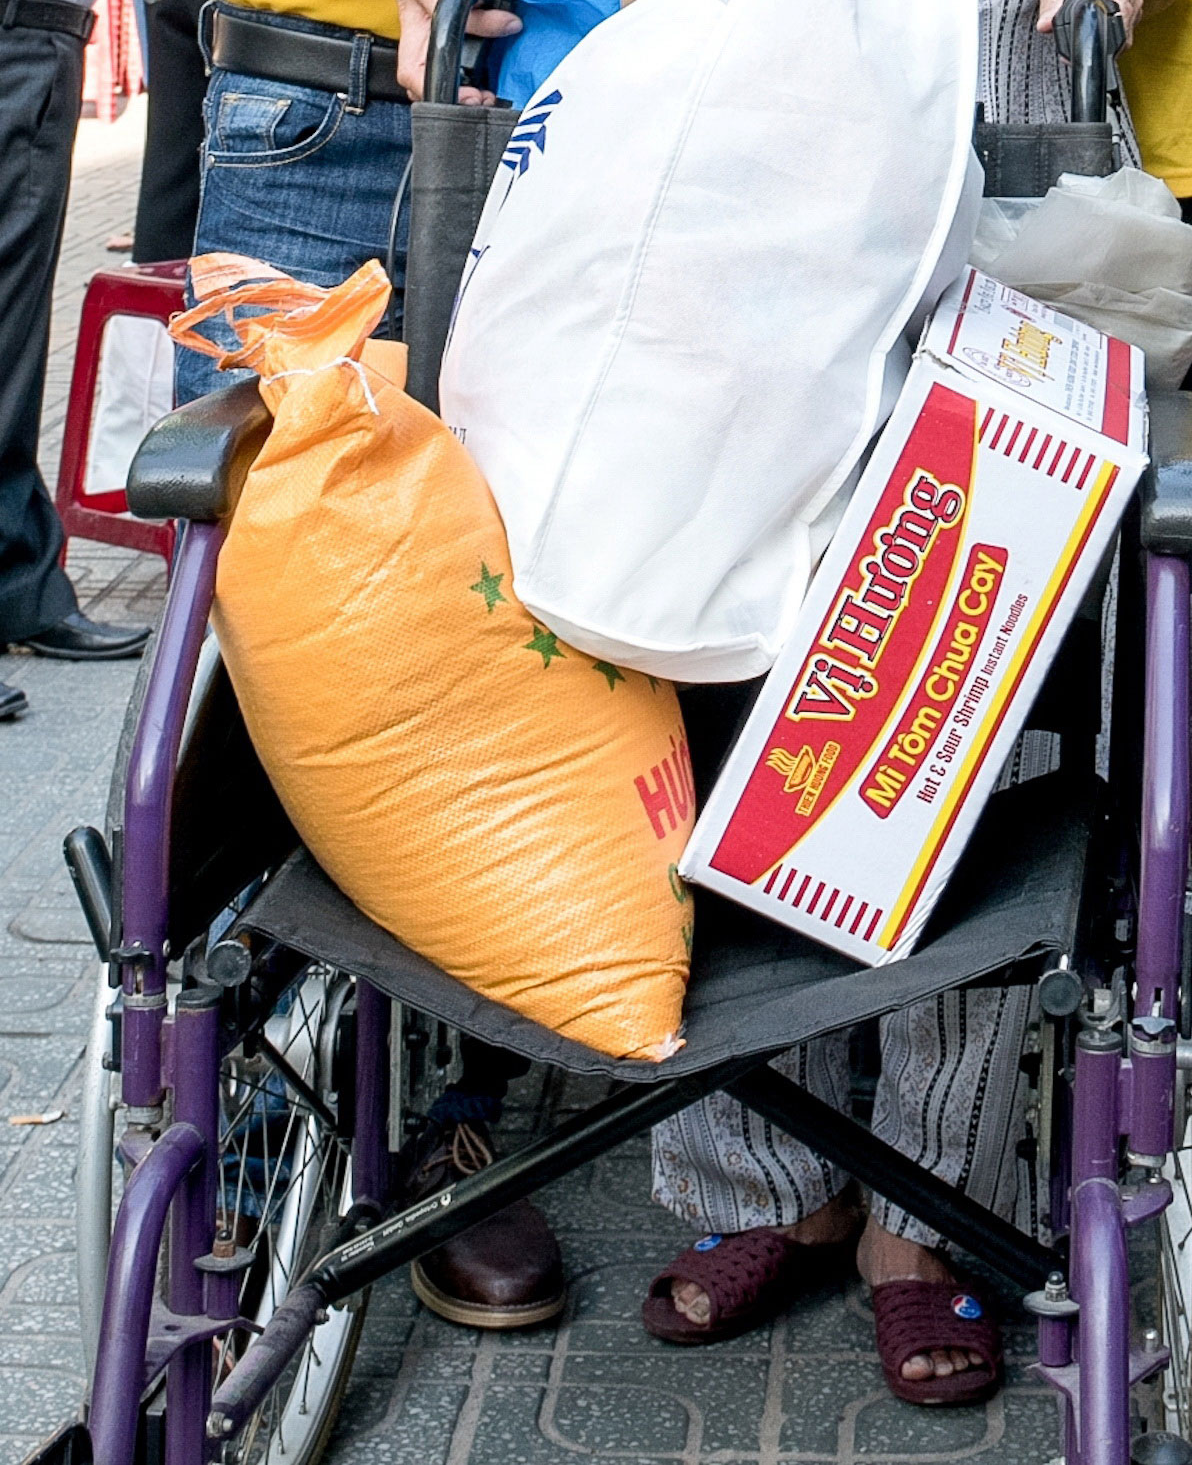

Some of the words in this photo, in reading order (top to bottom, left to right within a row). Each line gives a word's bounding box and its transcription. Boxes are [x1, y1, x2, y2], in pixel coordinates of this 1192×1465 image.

[827, 475, 963, 663] Hương
[793, 658, 875, 716] Vị
[822, 744, 838, 765] FOOD
[864, 764, 907, 808] Mì
[888, 705, 942, 767] Tôm
[924, 621, 980, 702] Chua
[958, 551, 1004, 616] Cay
[916, 777, 942, 805] Hot
[935, 727, 964, 764] Sour
[953, 675, 990, 728] Shrimp
[980, 633, 1009, 677] Instant
[999, 593, 1029, 638] Noodles
